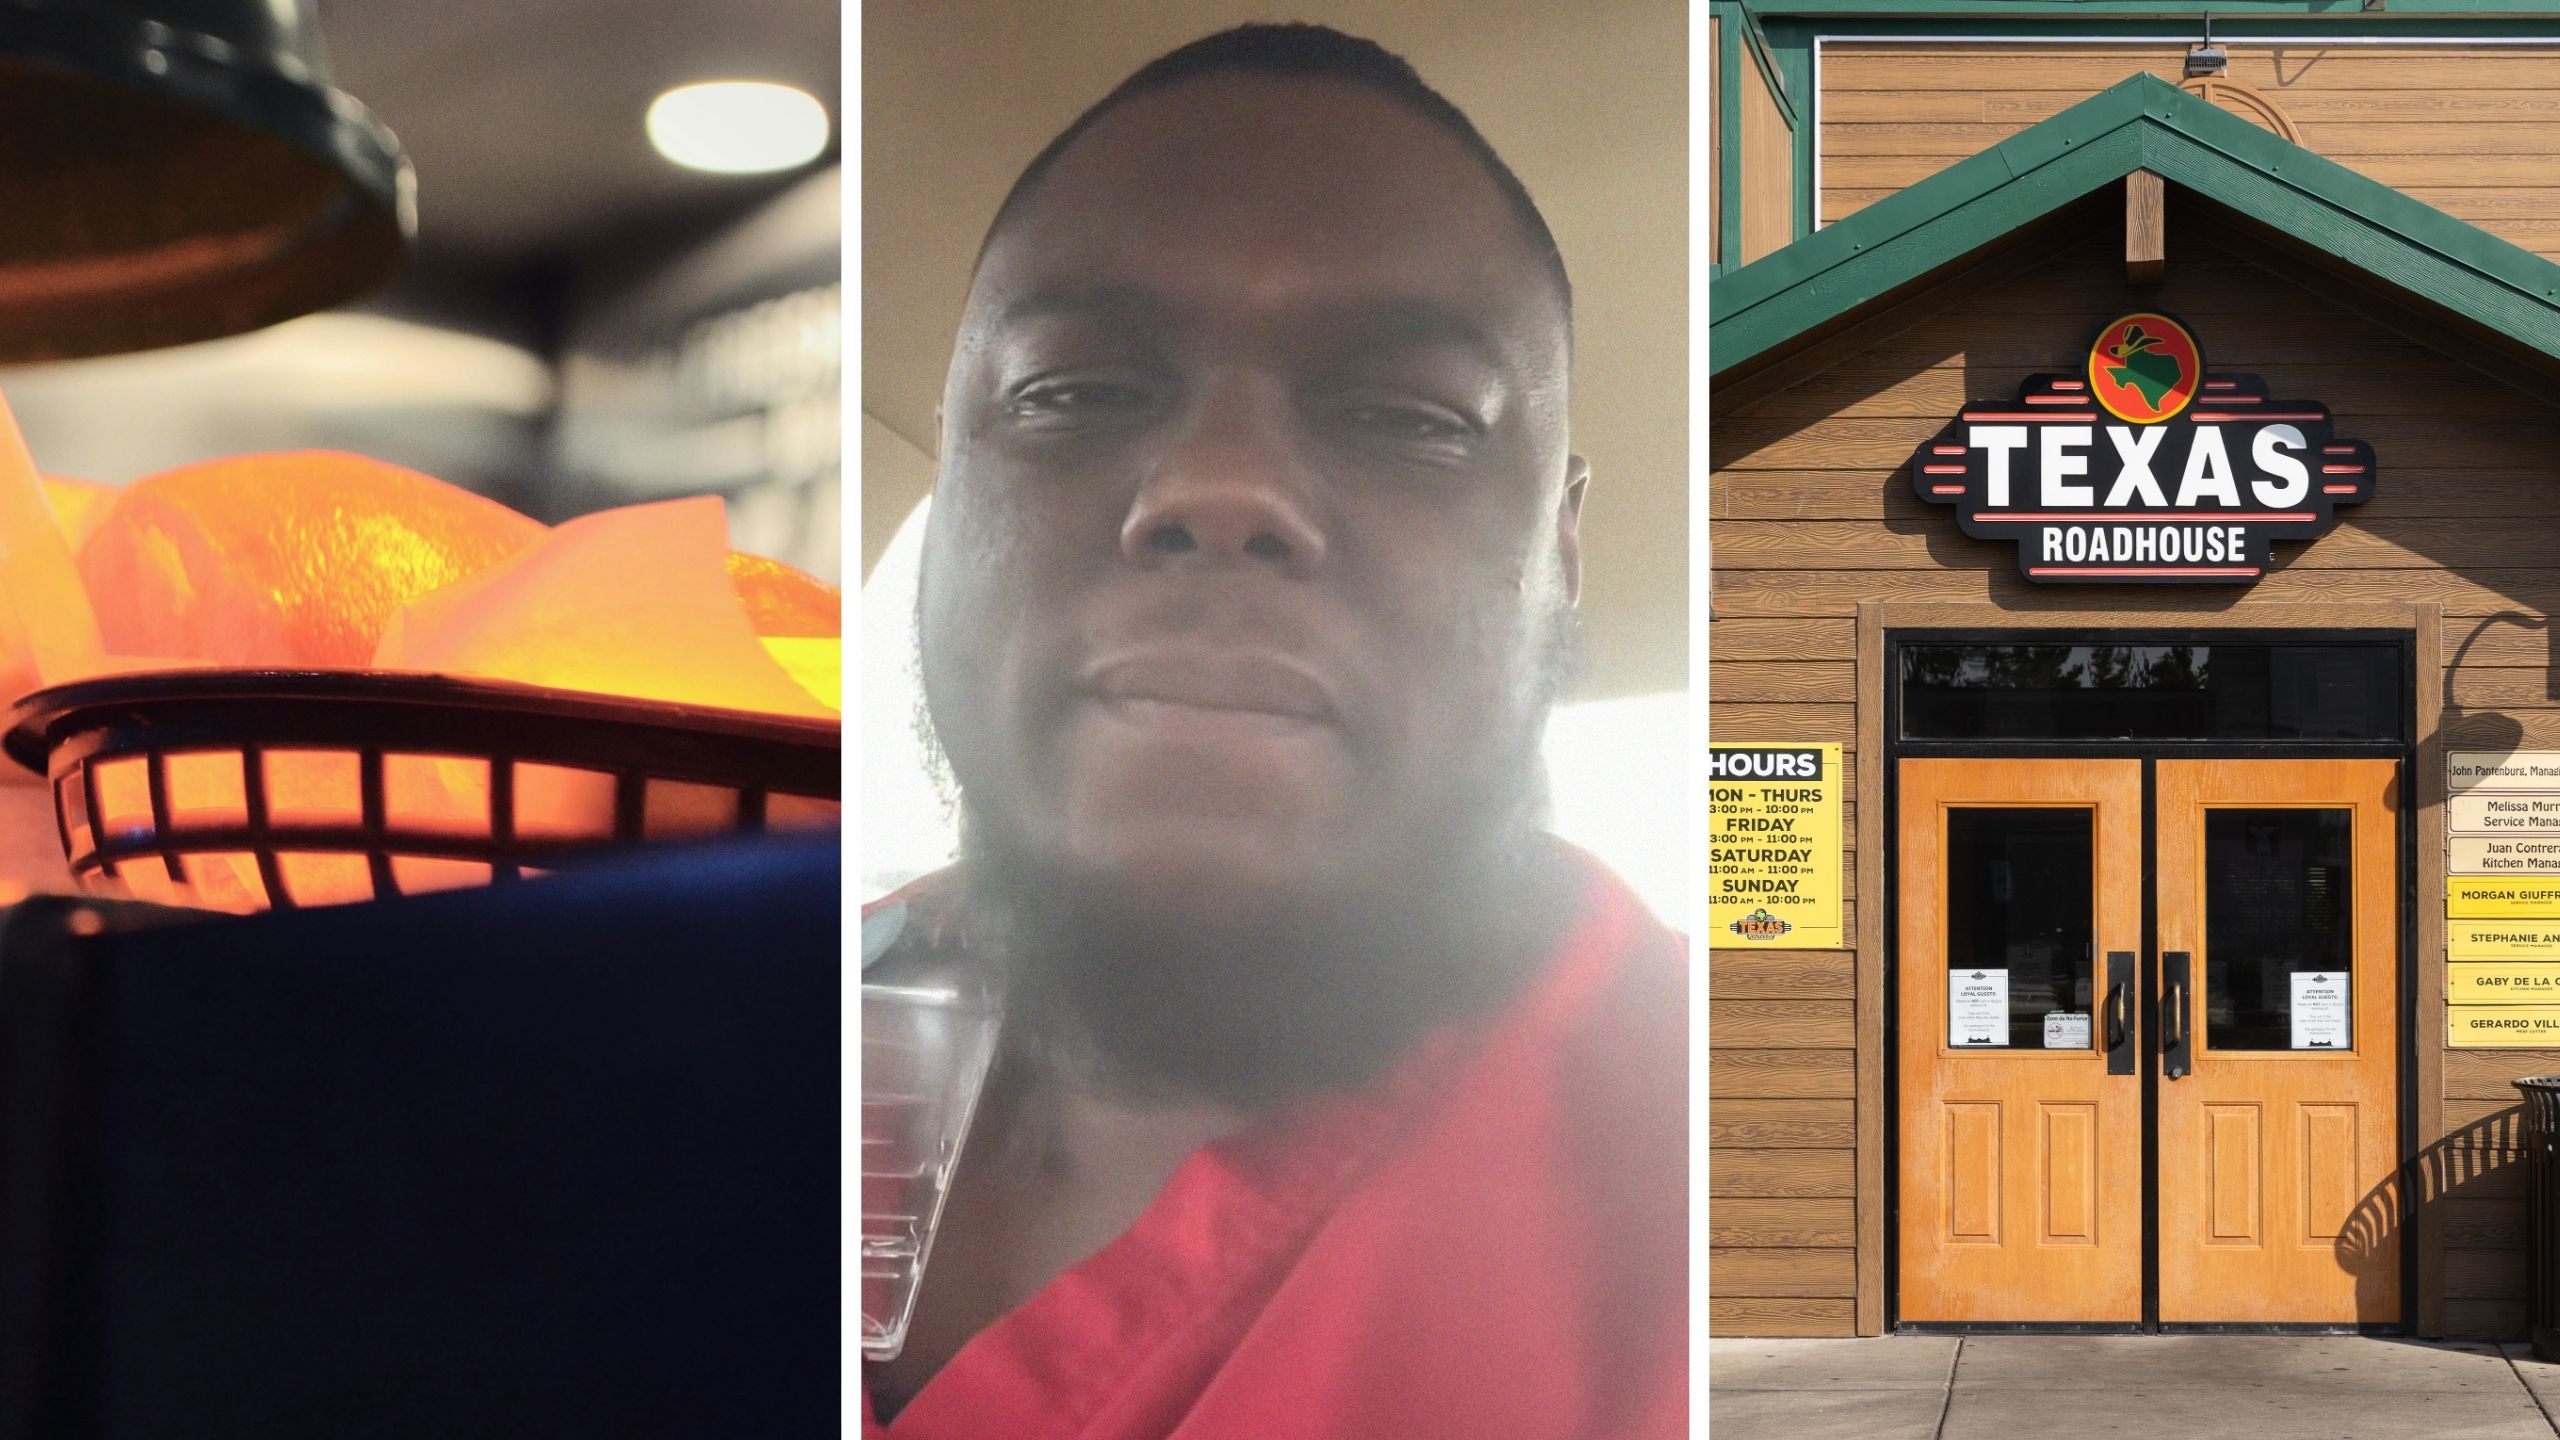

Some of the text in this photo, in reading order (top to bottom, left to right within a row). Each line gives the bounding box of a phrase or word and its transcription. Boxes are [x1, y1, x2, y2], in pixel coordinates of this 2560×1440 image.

[1969, 423, 2309, 509] TEXAS
[2042, 526, 2245, 562] ROADHOUSE
[1709, 753, 1817, 777] HOURS
[2452, 766, 2472, 776] John
[2475, 766, 2528, 777] Pantenburg,
[1761, 789, 1823, 802] THURS
[1709, 804, 1737, 814] 3:00
[1765, 804, 1798, 814] 10:00
[2488, 801, 2529, 812] Melissa
[1726, 818, 1795, 831] FRIDAY
[2484, 816, 2560, 828] Service Mana
[1710, 834, 1737, 844] 3:00
[1766, 834, 1797, 844] 11:00
[2487, 842, 2512, 854] Juan
[1710, 849, 1812, 862] SATURDAY
[2482, 858, 2524, 869] Kitchen
[1709, 865, 1738, 874] 11:00
[1767, 865, 1798, 874] 11:00
[1723, 879, 1799, 892] SUNDAY
[1709, 895, 1738, 904] 11:00
[1766, 895, 1800, 904] 10:00
[2461, 890, 2515, 900] MORGAN
[1738, 920, 1784, 934] TEXAS
[2471, 933, 2538, 943] STEPHANIE
[2476, 977, 2510, 986] GABY
[2514, 977, 2530, 986] DE
[2534, 977, 2551, 986] LA
[2470, 1019, 2559, 1029] GERARDO VILL
